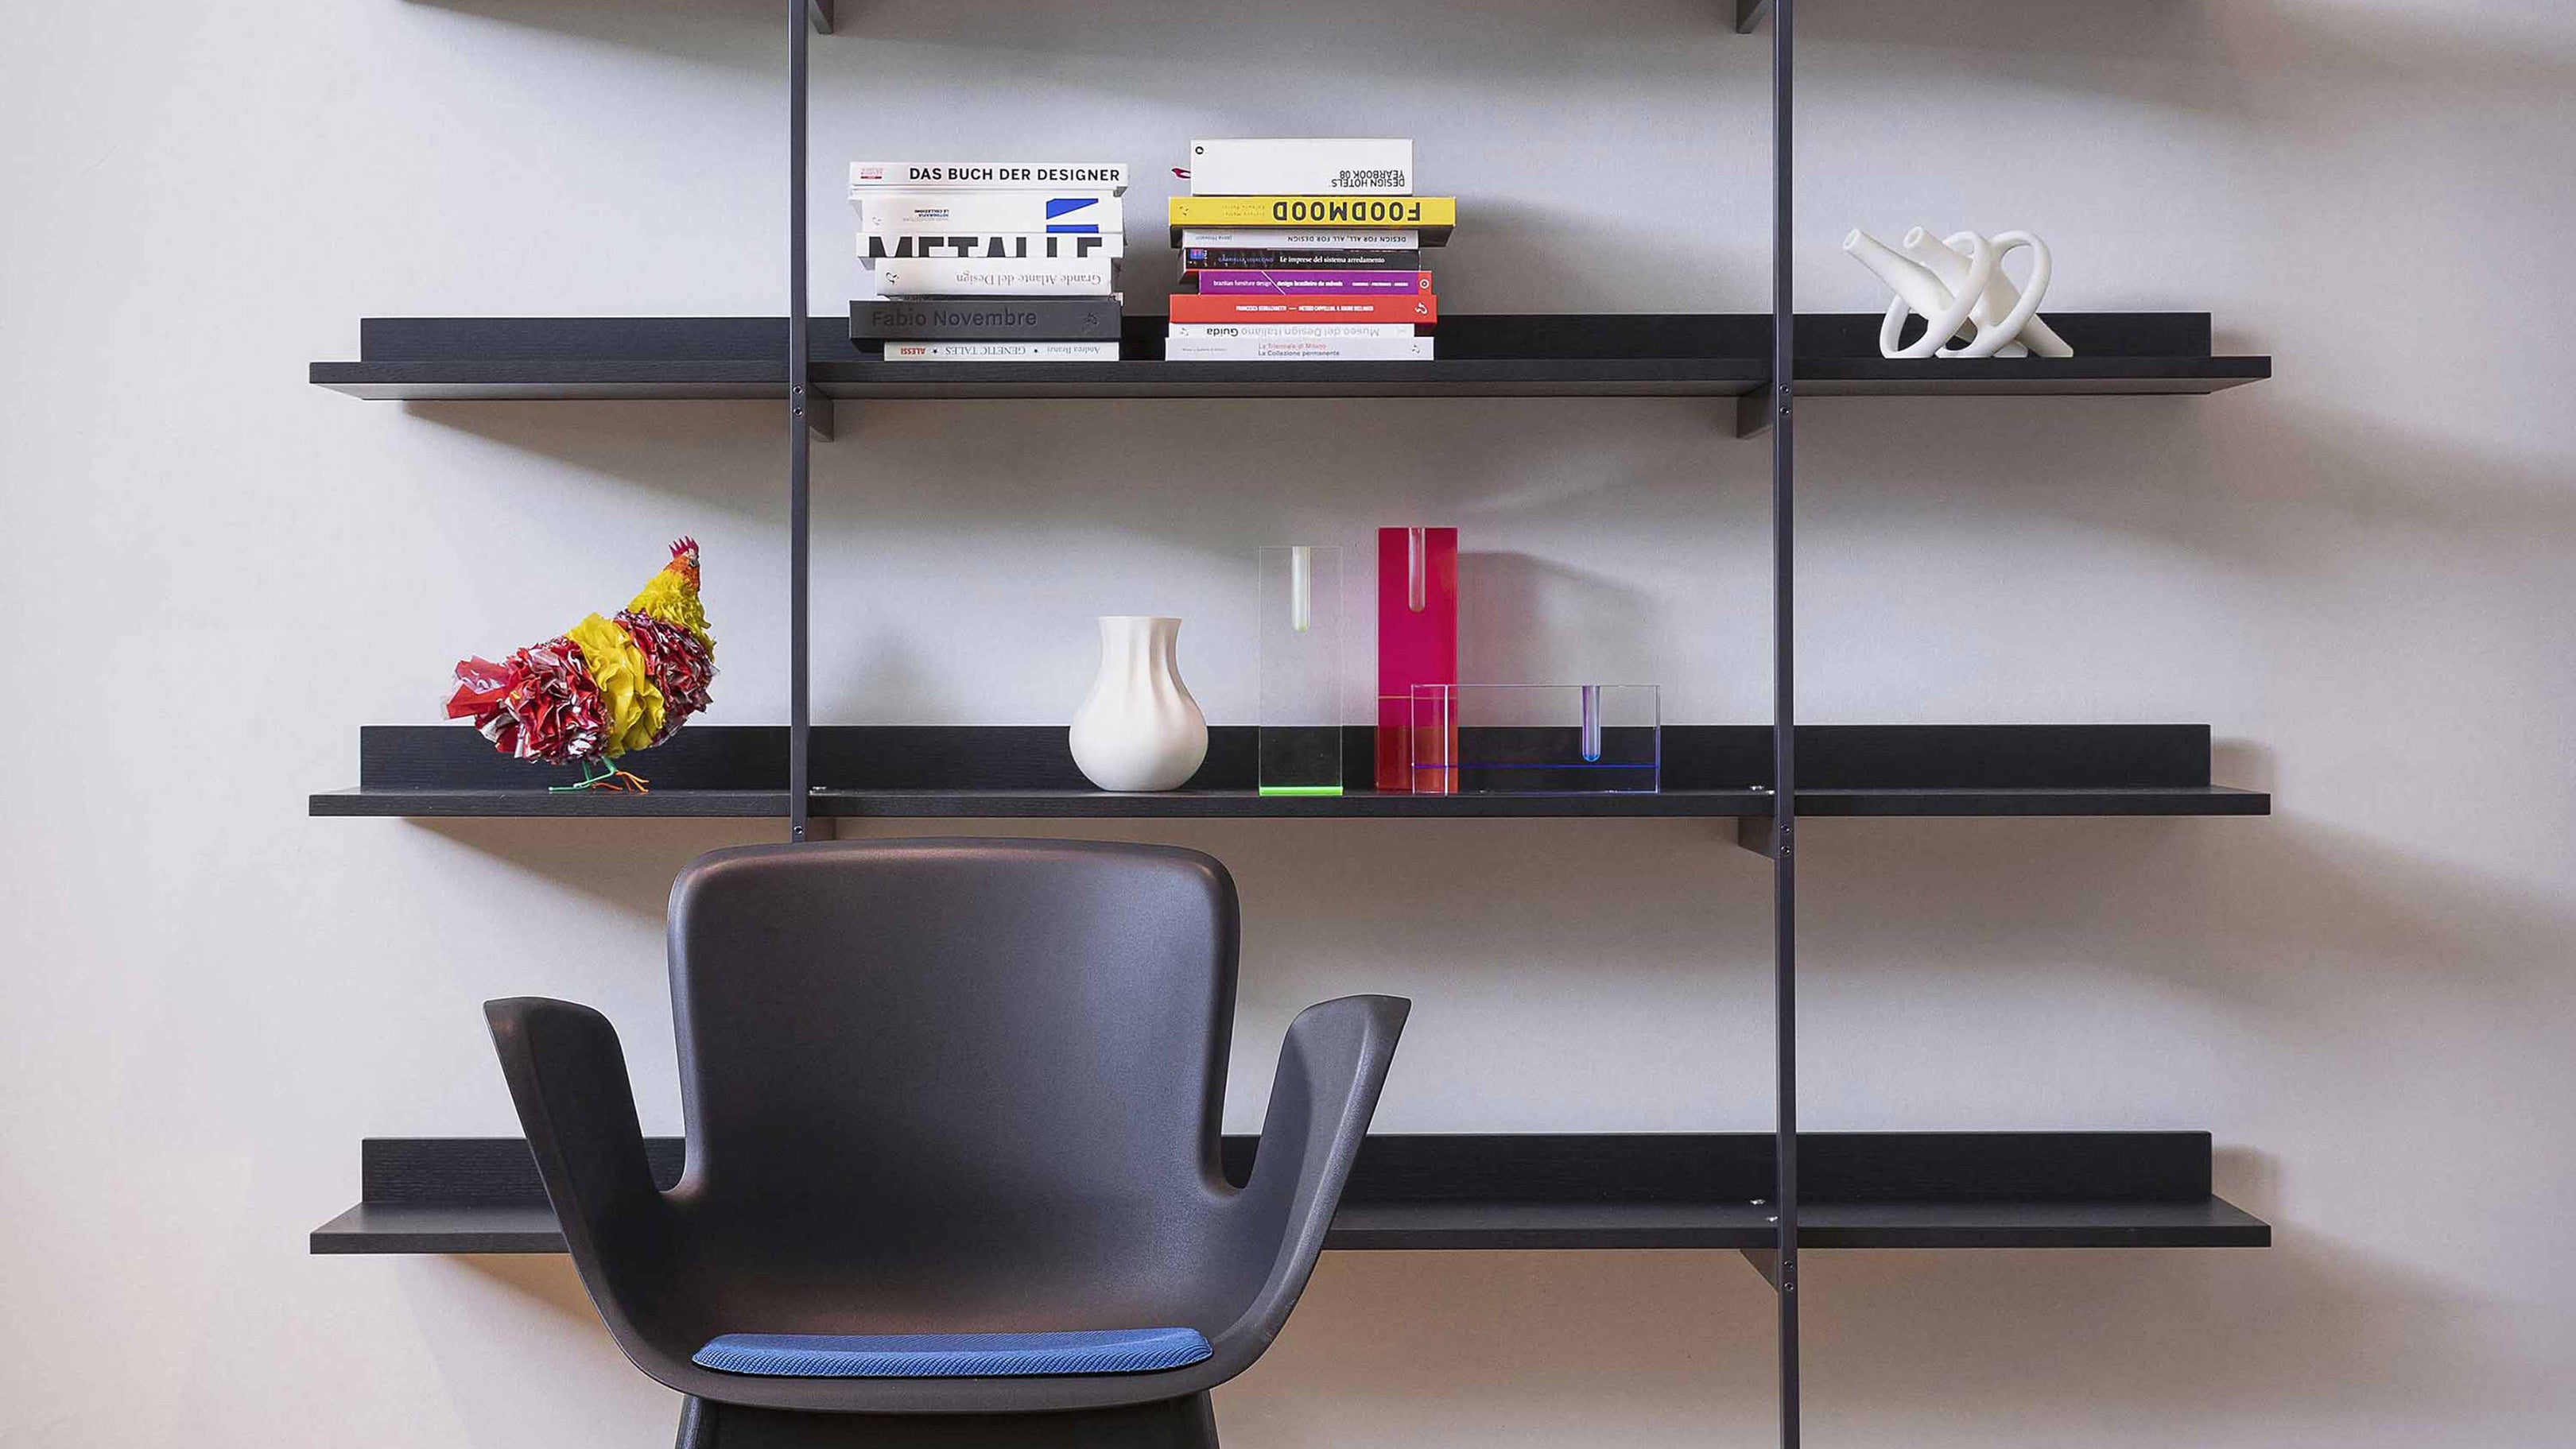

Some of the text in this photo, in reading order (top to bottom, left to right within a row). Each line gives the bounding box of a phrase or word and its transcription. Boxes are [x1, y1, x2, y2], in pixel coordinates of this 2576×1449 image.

[910, 168, 1119, 181] DAS BUCH DER DESIGNER
[1340, 169, 1405, 179] YEARBOOK 08
[1332, 178, 1405, 188] DESIGN HOTELS
[1273, 201, 1421, 222] FOODMOOD
[956, 271, 1102, 285] Grande Atlante del Design
[872, 306, 1038, 327] Fabio Novembre
[1207, 327, 1239, 338] Guida
[1241, 327, 1282, 338] Italiano
[1284, 326, 1321, 338] Design
[1344, 327, 1379, 337] Museo
[945, 346, 978, 355] TALES
[980, 346, 1026, 355] GENETIC
[1074, 346, 1100, 355] Andrea
